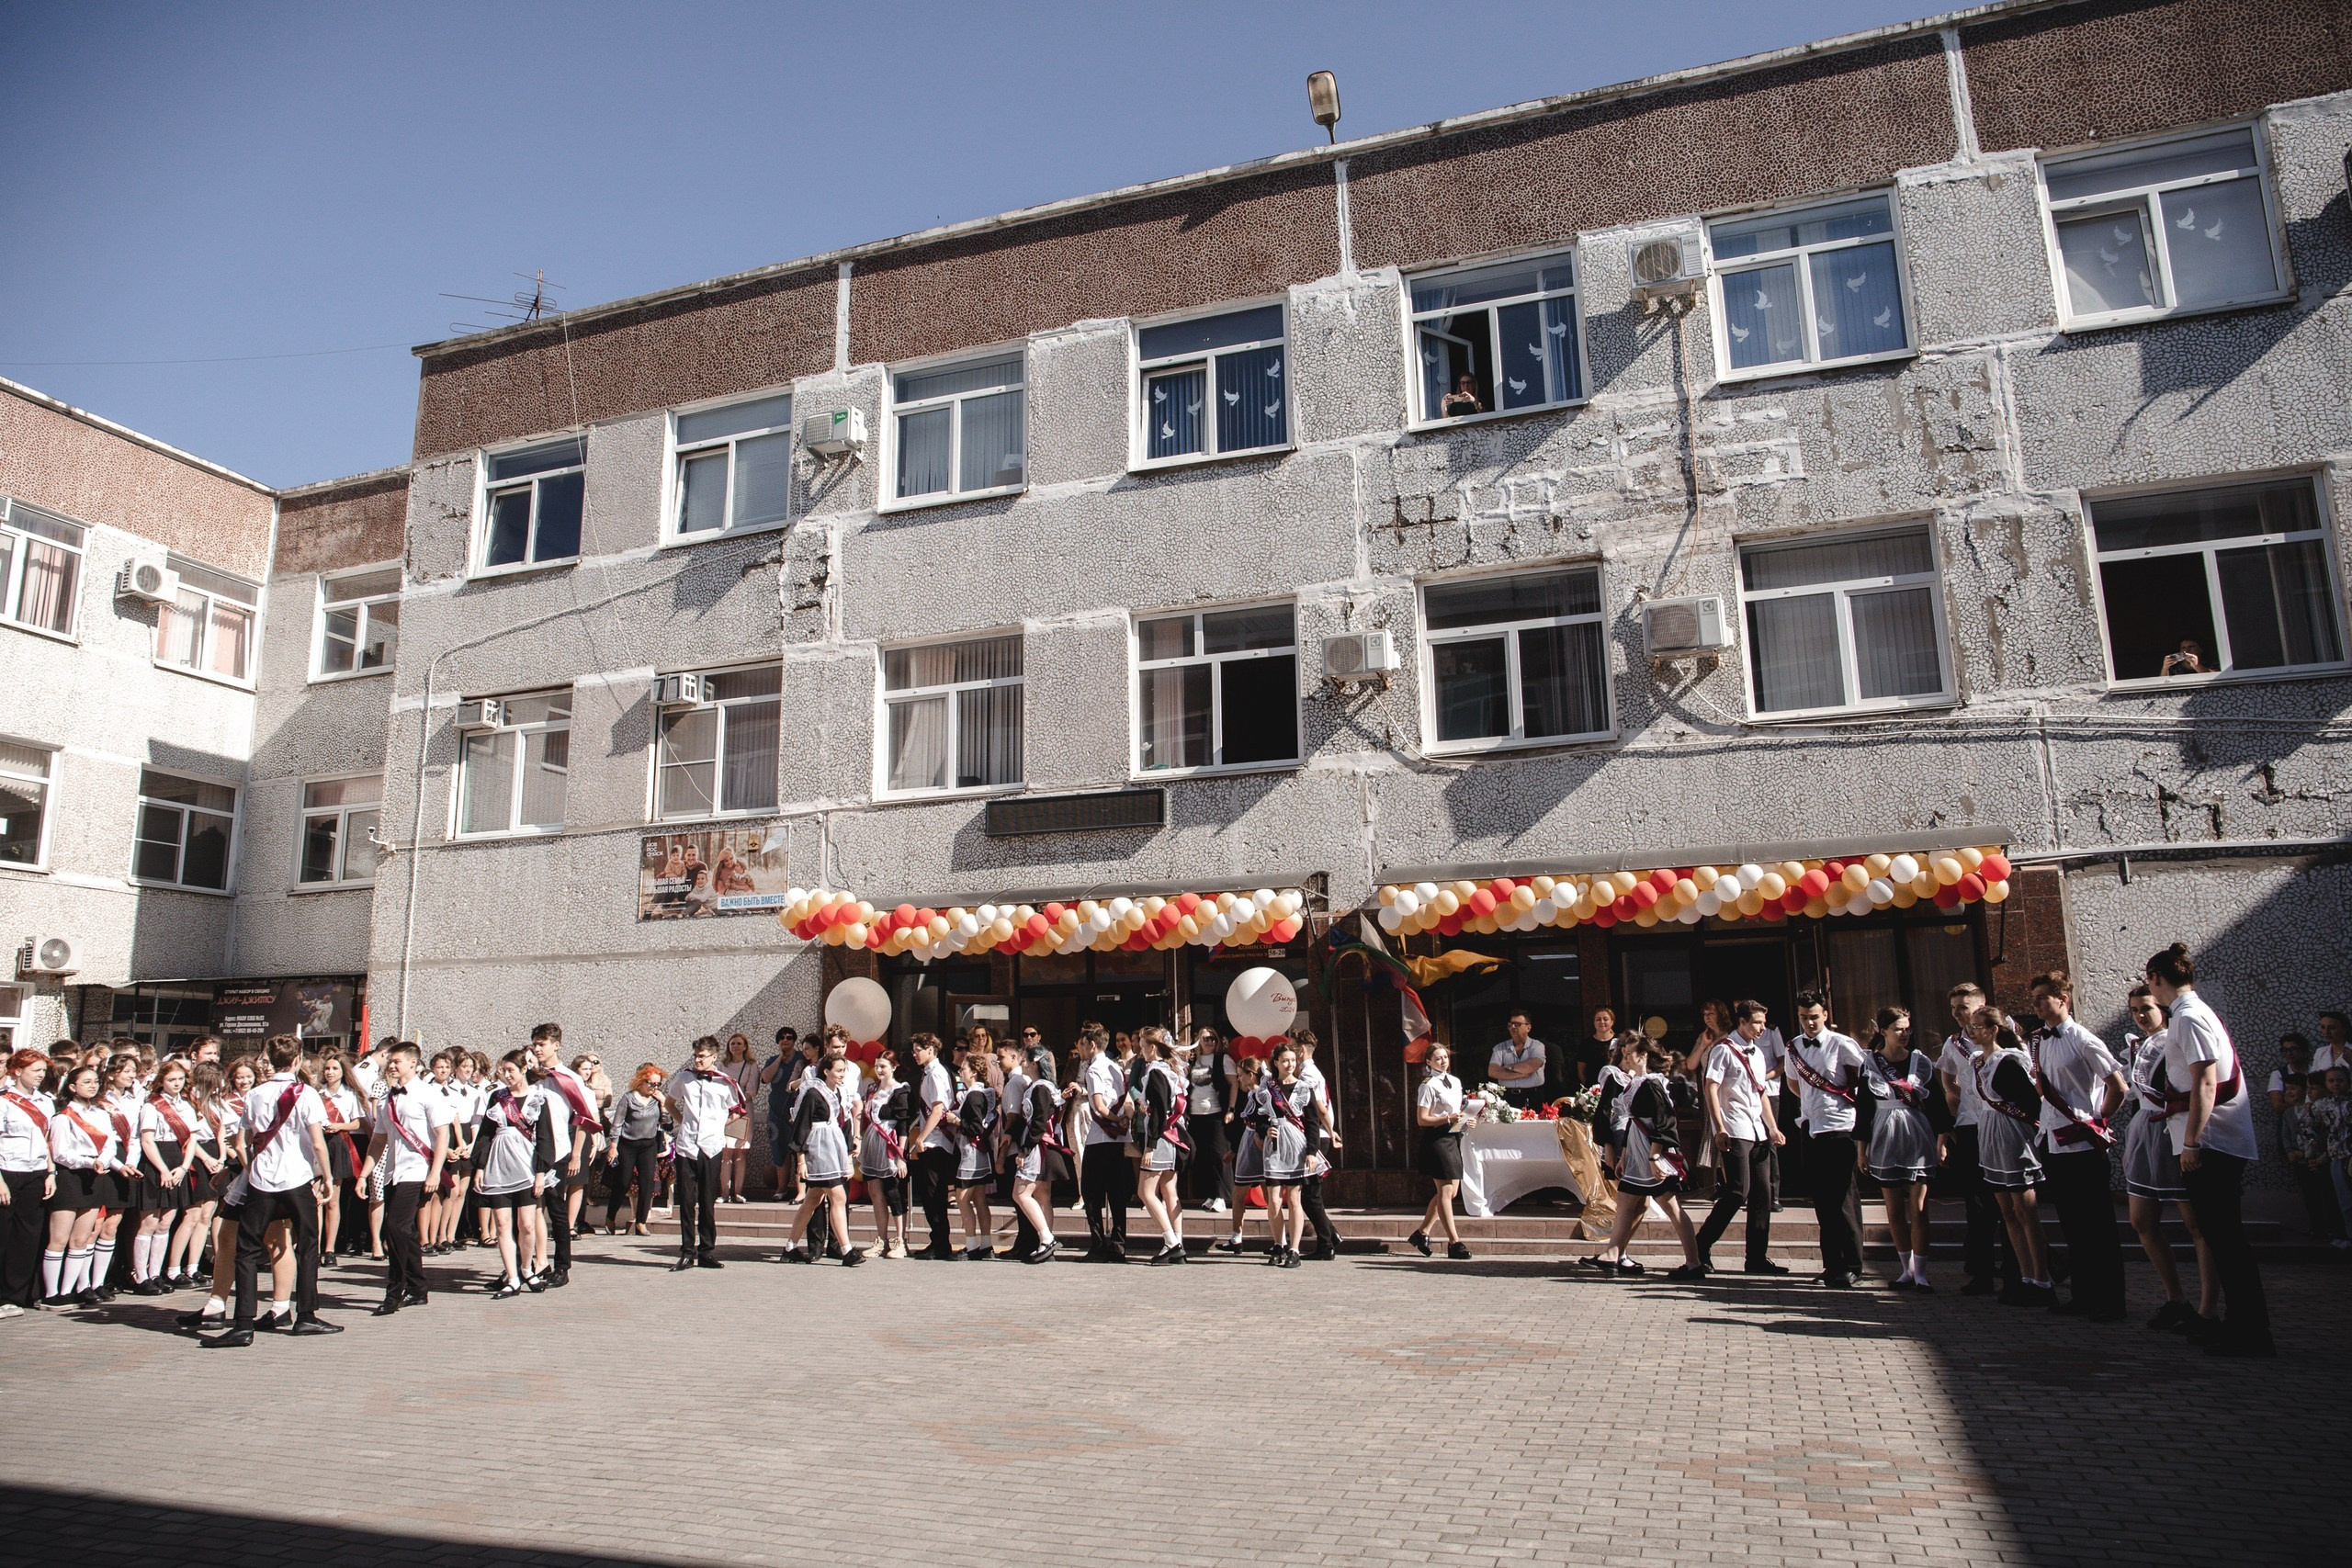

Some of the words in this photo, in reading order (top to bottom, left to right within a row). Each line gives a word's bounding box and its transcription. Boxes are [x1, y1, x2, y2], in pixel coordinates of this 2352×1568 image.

[720, 897, 742, 907] ВАЖНО
[743, 897, 760, 906] БЫТЬ
[761, 895, 785, 905] ВМЕСТЕ
[217, 995, 277, 1005] ДЖИУ-ДЖИТСУ
